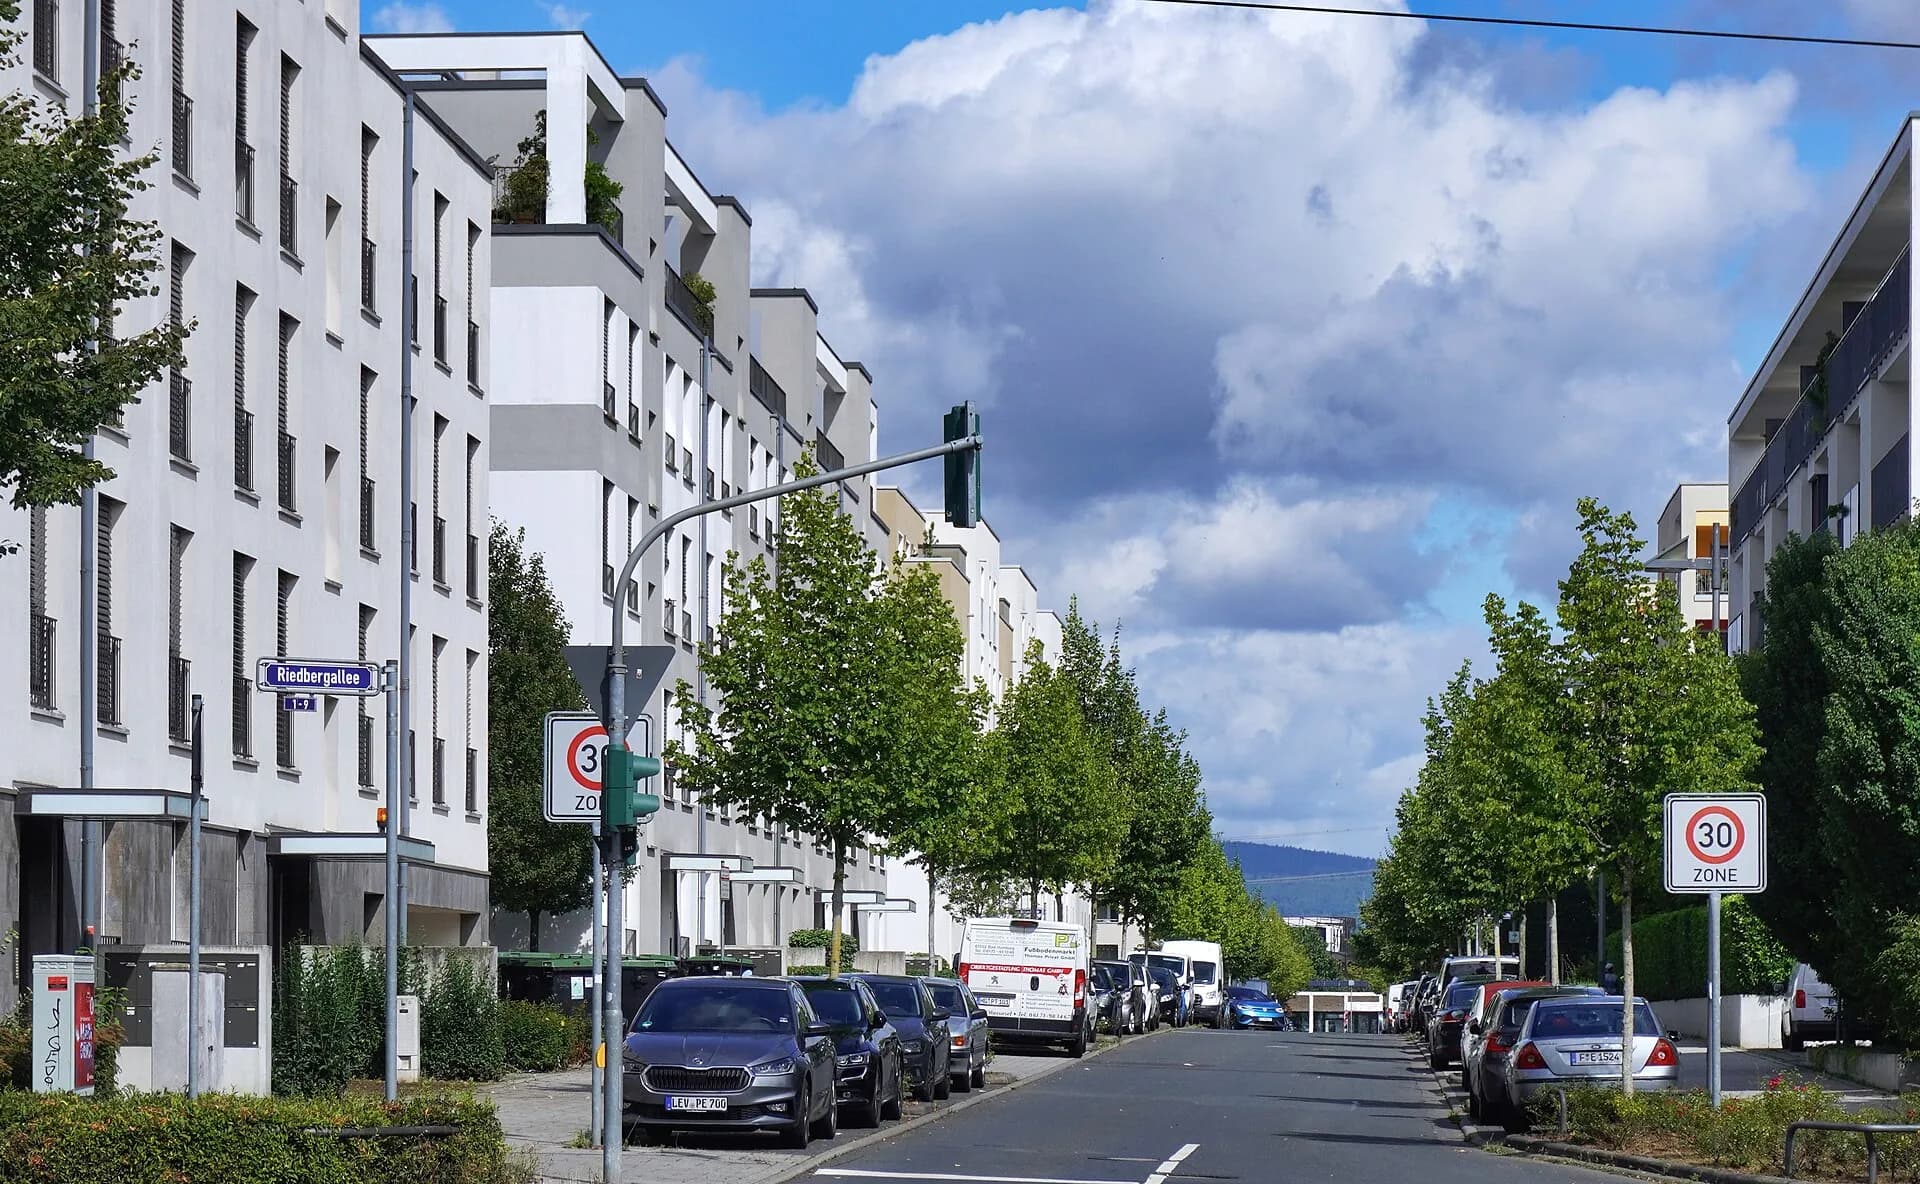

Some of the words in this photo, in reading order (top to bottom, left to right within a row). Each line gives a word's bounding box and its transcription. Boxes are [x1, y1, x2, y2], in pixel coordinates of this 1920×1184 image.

[277, 666, 360, 687] Riedbergallee
[292, 699, 309, 710] 1-9
[575, 795, 602, 811] ZO
[1698, 822, 1732, 848] 30
[1693, 868, 1738, 882] ZONE
[1598, 1052, 1620, 1061] 1524
[672, 1098, 689, 1108] LEV
[696, 1099, 707, 1108] PE
[710, 1099, 726, 1109] 700
